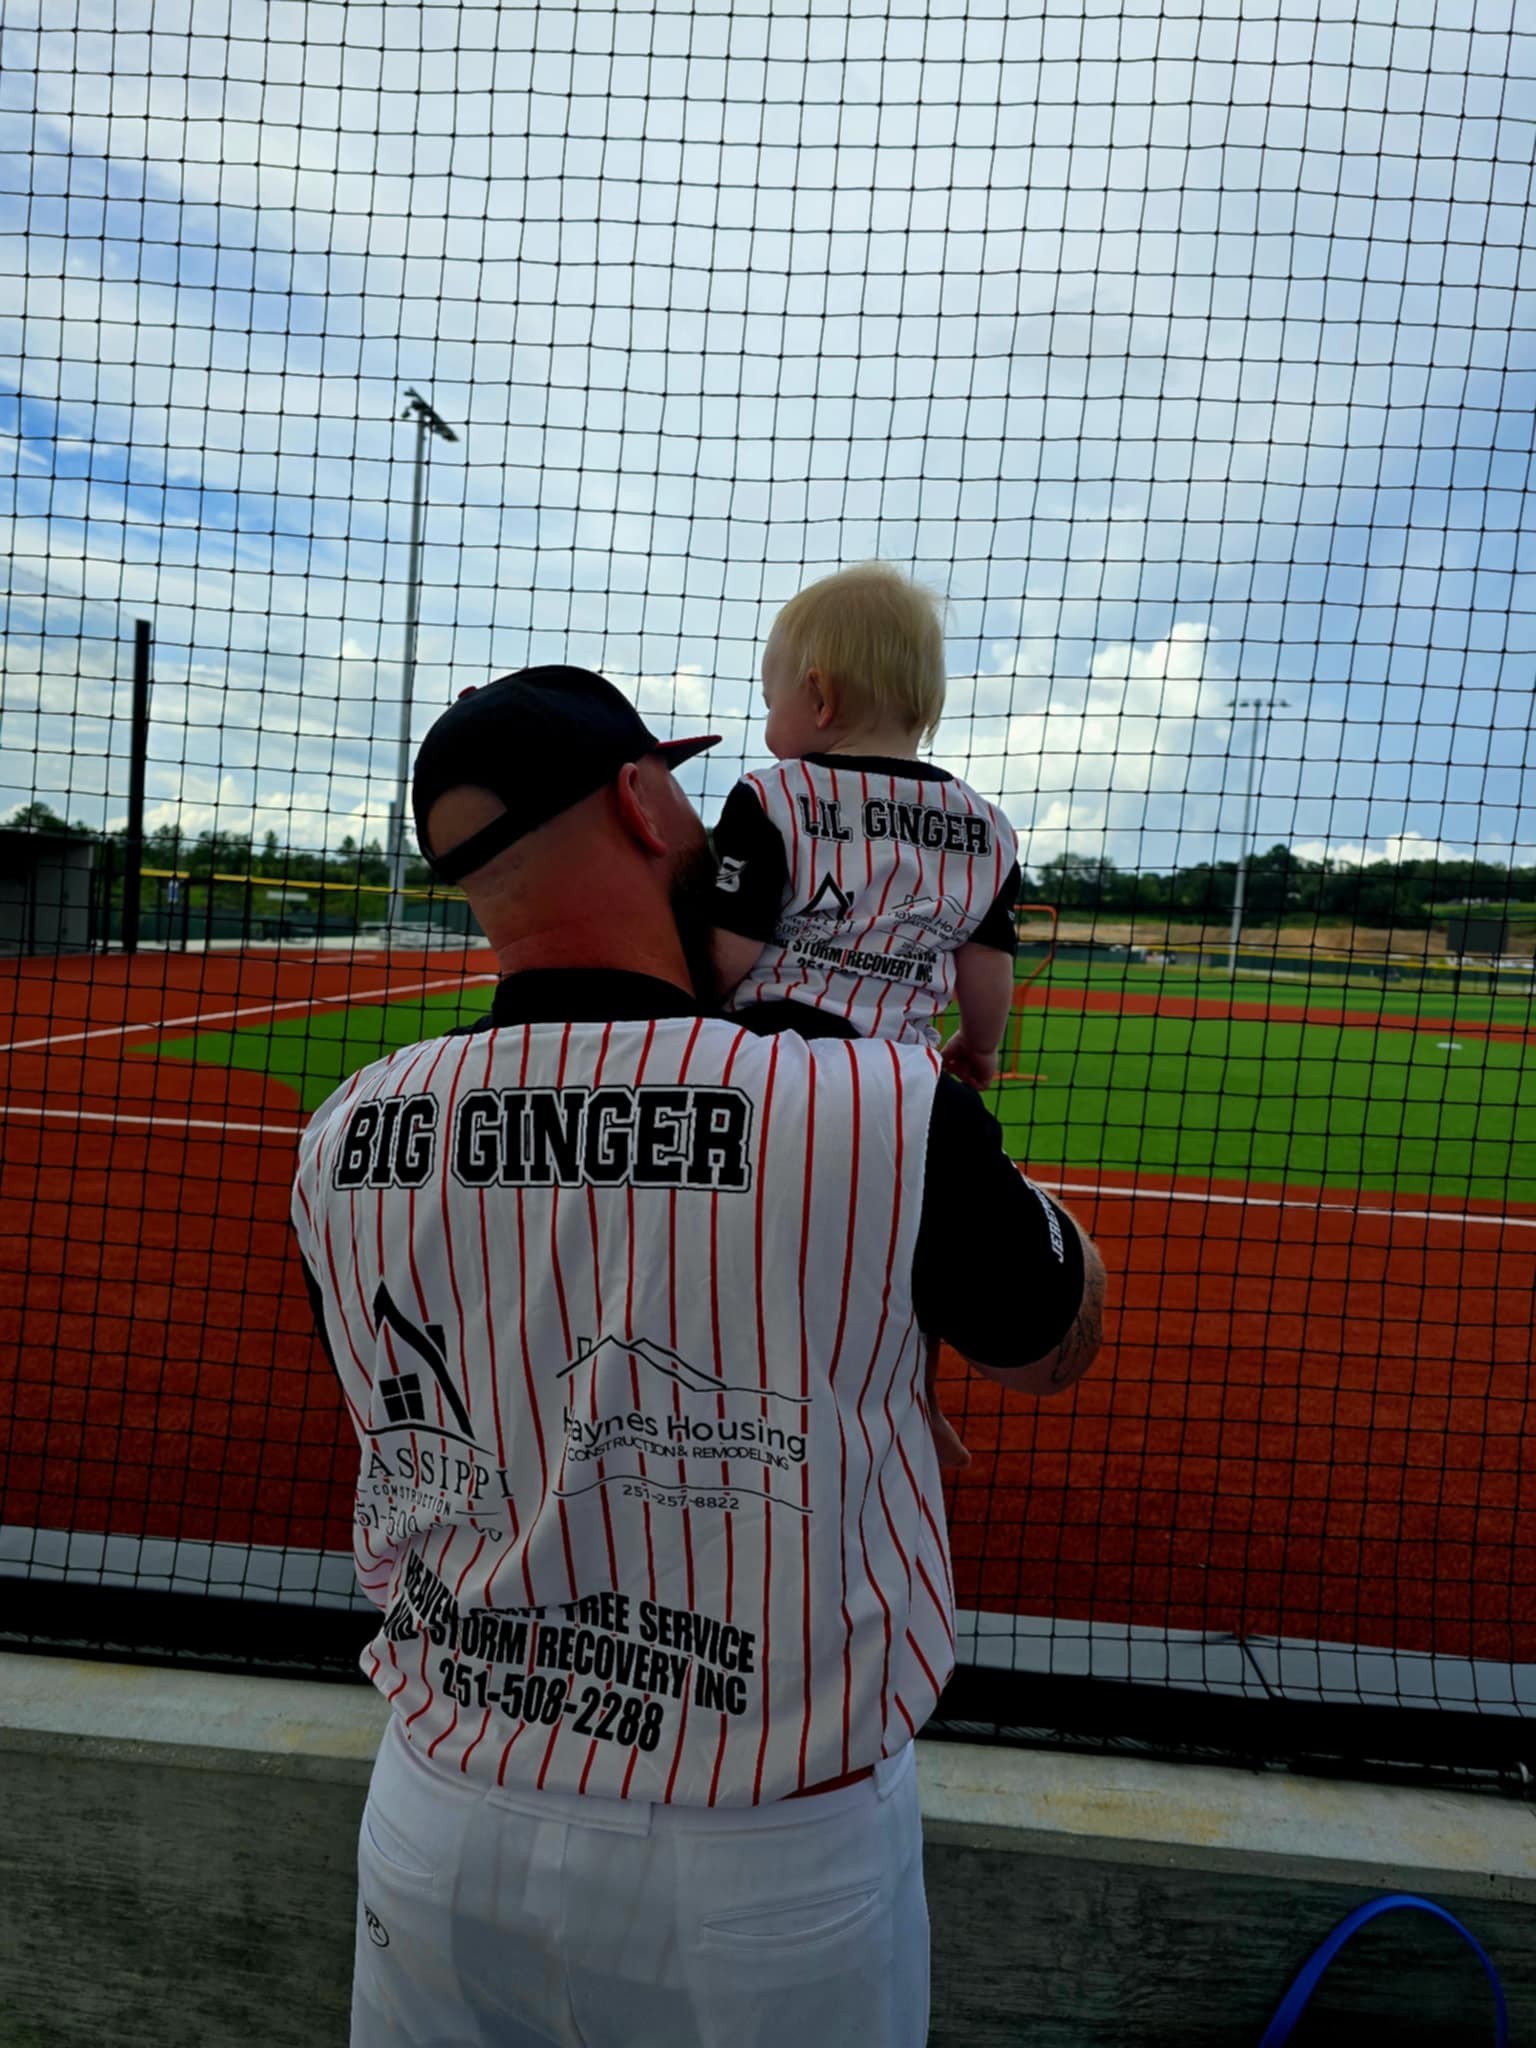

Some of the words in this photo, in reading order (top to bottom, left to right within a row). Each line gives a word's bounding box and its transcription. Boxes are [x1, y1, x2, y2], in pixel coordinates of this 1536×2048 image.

[797, 794, 853, 842] LIL
[862, 799, 992, 856] GINGER
[846, 951, 917, 983] RECOVERY
[914, 962, 934, 984] INC
[333, 1092, 439, 1190] BIG
[452, 1084, 753, 1193] GINGER
[567, 1436, 676, 1462] CONSTRUCTION
[677, 1445, 689, 1458] &
[693, 1447, 790, 1471] REMODELING
[667, 1415, 806, 1462] Housing
[373, 1484, 452, 1517] CONSTRUCTION
[622, 1484, 740, 1510] 251-257-8822
[559, 1591, 630, 1635] TREE
[639, 1600, 756, 1674] SERVICE
[429, 1612, 527, 1666] STORM
[536, 1626, 689, 1700] RECOVERY
[694, 1664, 748, 1716] INC
[439, 1658, 665, 1753] 251-508-2288
